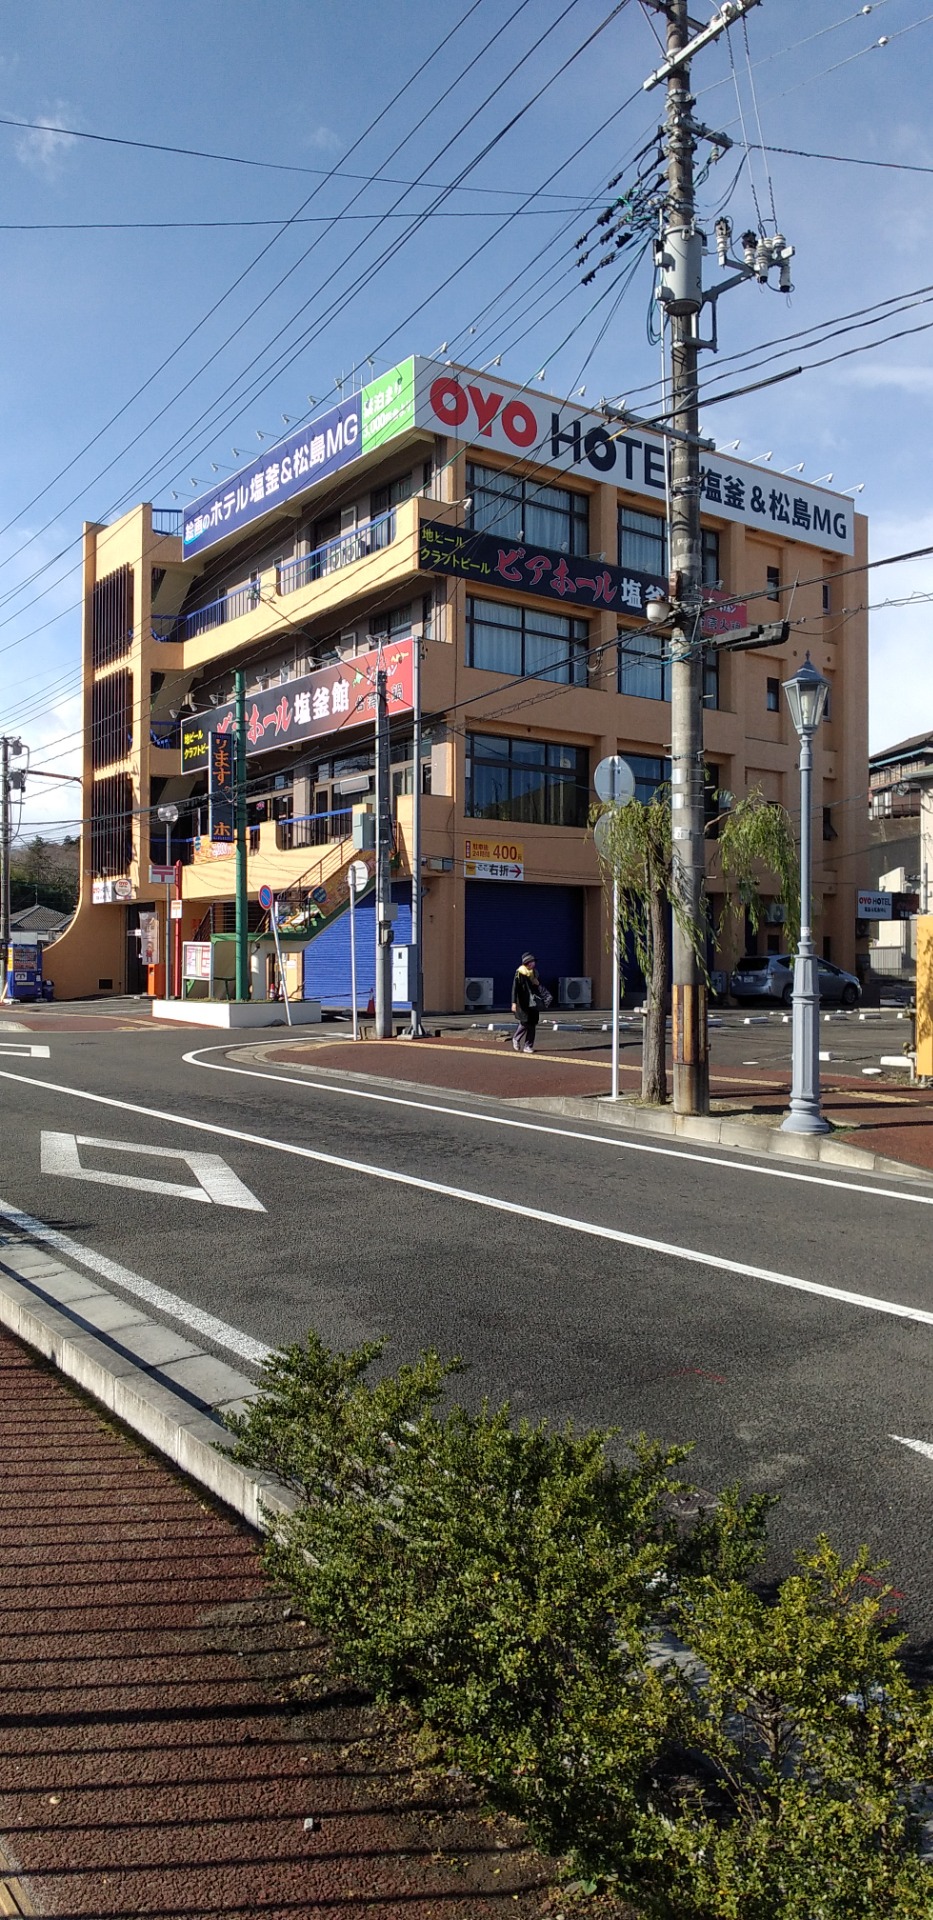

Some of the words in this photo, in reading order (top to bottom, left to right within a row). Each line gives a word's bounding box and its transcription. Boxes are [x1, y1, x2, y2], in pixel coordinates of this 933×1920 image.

[430, 377, 537, 447] OYO
[551, 412, 673, 490] HOTE
[421, 528, 465, 549] 地ビール
[420, 547, 491, 575] クラフトビール
[859, 896, 872, 905] OYO
[872, 897, 892, 906] HOTEL
